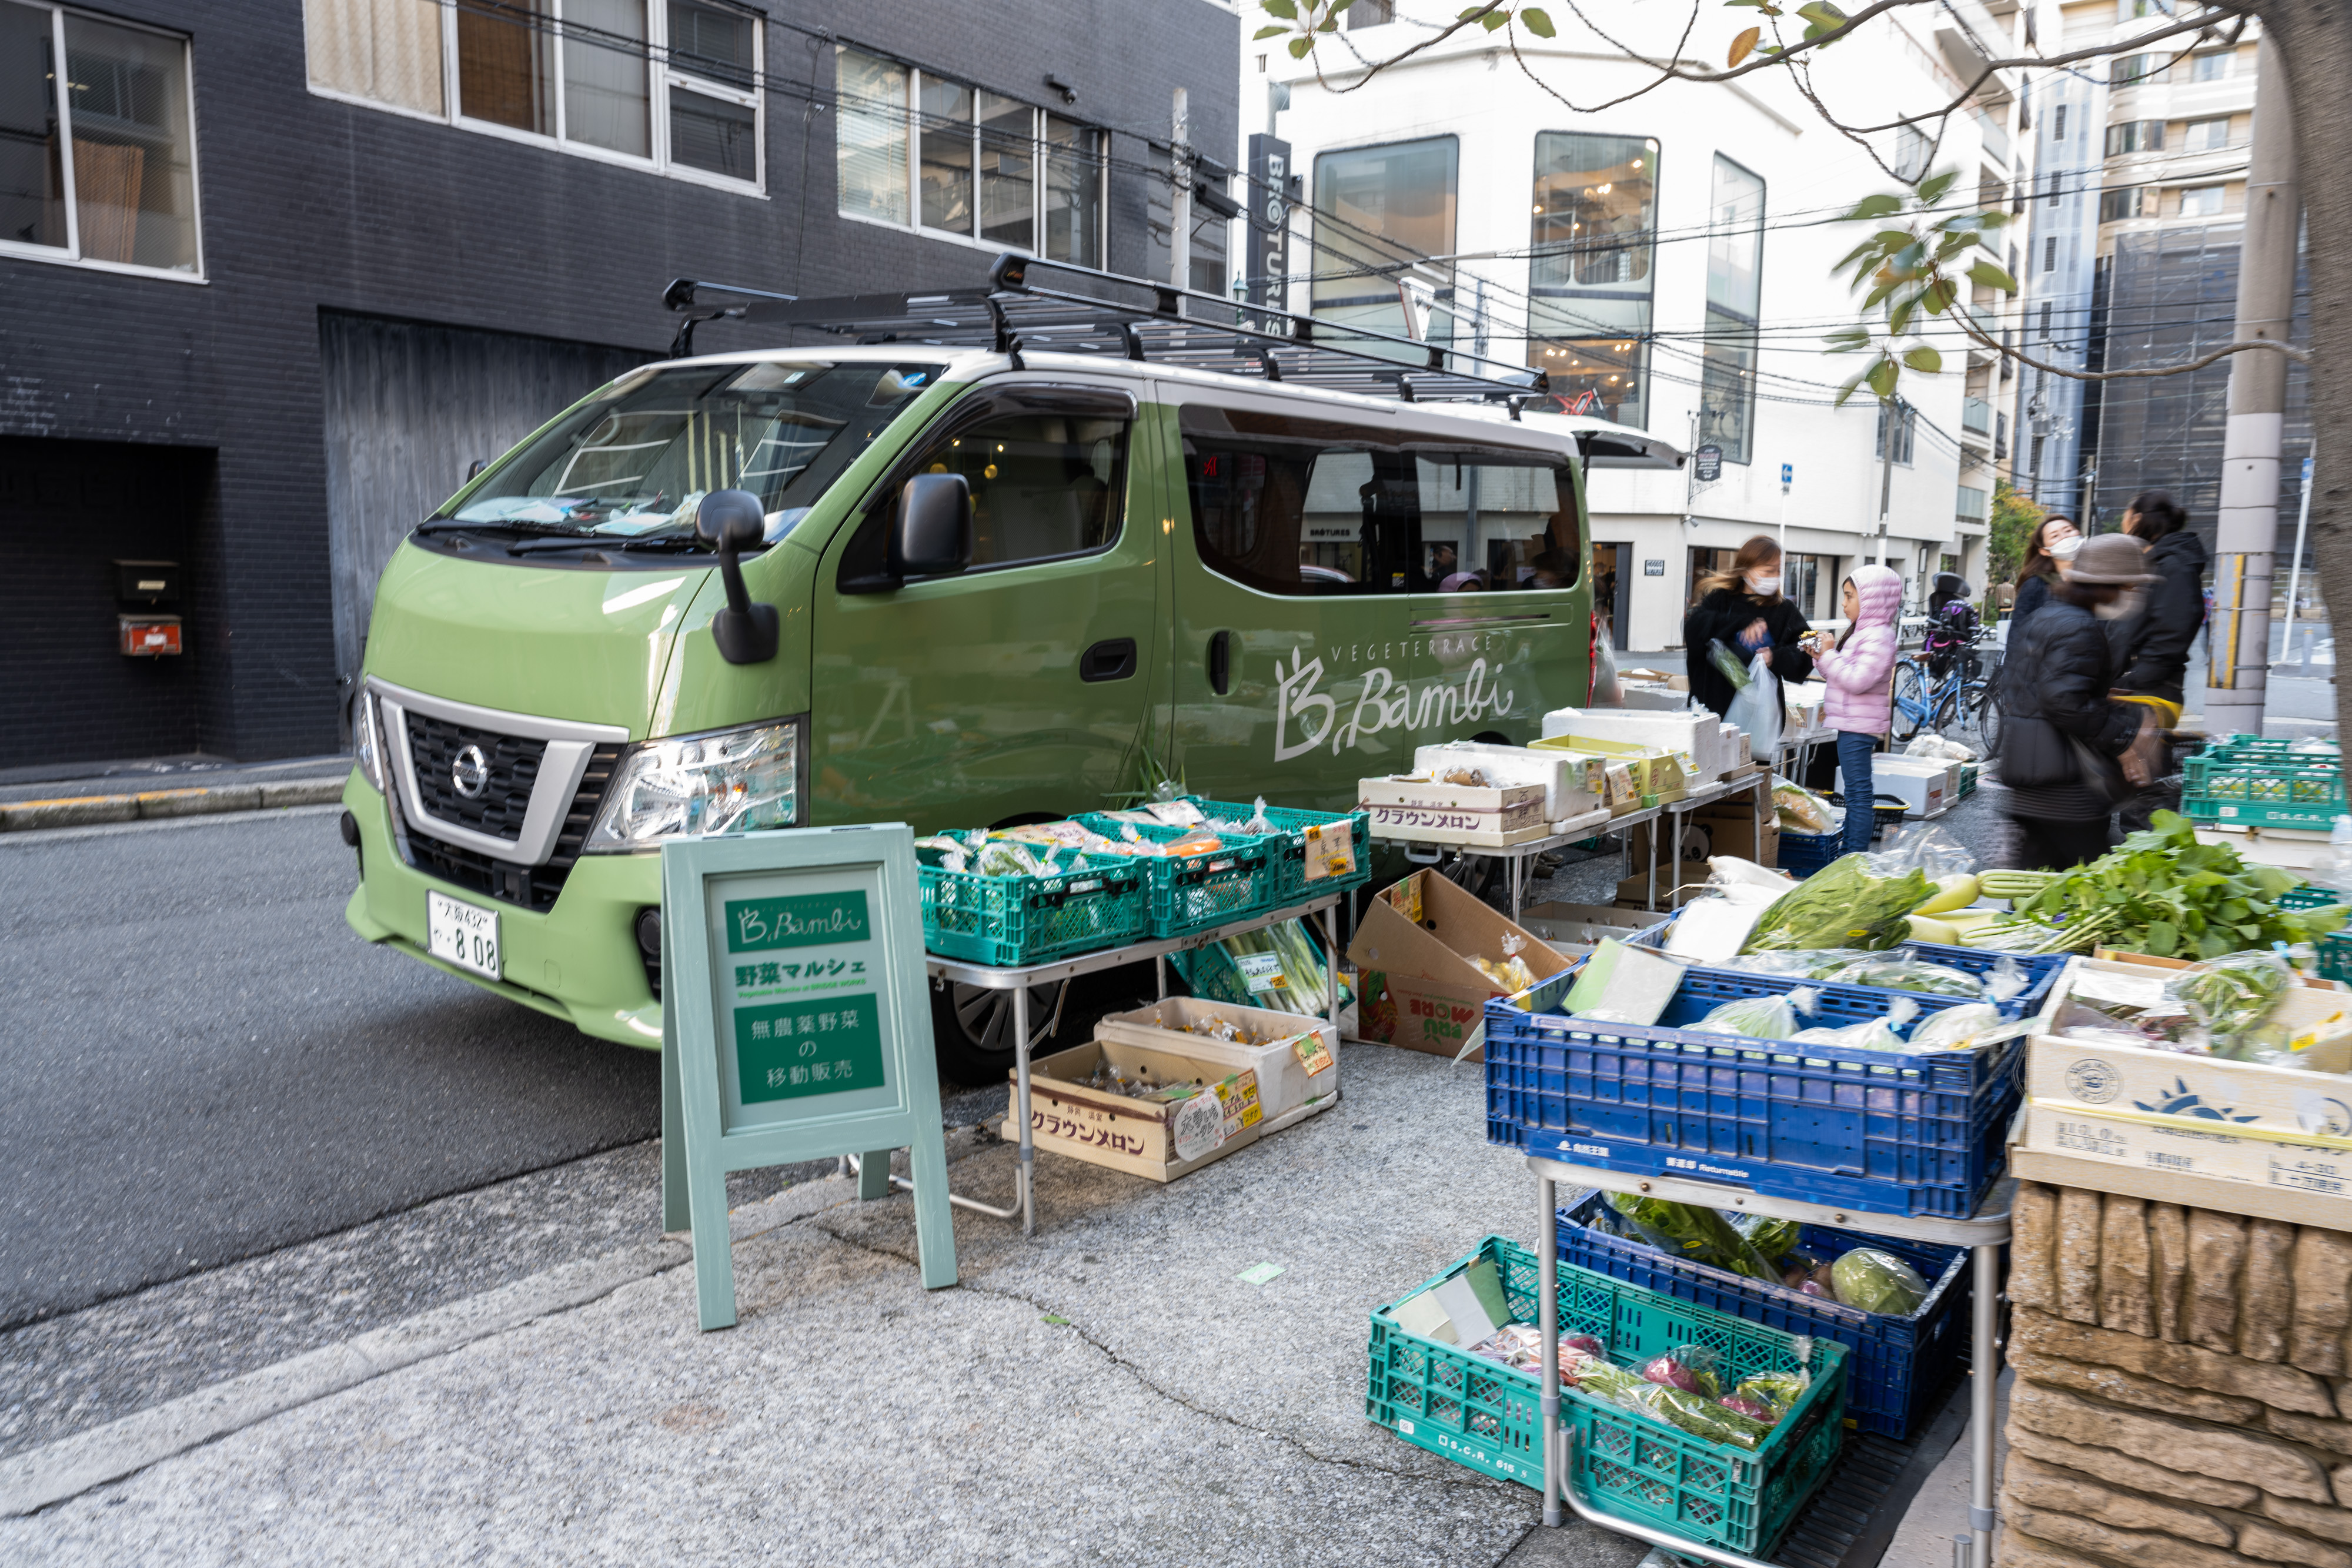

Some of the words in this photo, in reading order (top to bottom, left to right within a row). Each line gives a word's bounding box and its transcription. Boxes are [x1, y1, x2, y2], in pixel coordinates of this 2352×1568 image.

[1331, 636, 1491, 663] VEGETERRACE
[1332, 657, 1514, 757] Bambi
[1376, 807, 1481, 830] クラウンメロン
[767, 908, 861, 943] Bambi
[734, 957, 867, 988] 野菜マルシェ
[750, 1008, 860, 1041] 無農薬野菜
[1410, 999, 1475, 1024] MORE
[798, 1040, 817, 1057] の
[766, 1058, 853, 1089] 移動販売
[1031, 1109, 1145, 1156] クラウンメロン
[1699, 1164, 1749, 1178] Returnable
[1450, 1440, 1490, 1464] S.C.R.
[1496, 1459, 1515, 1473] 615
